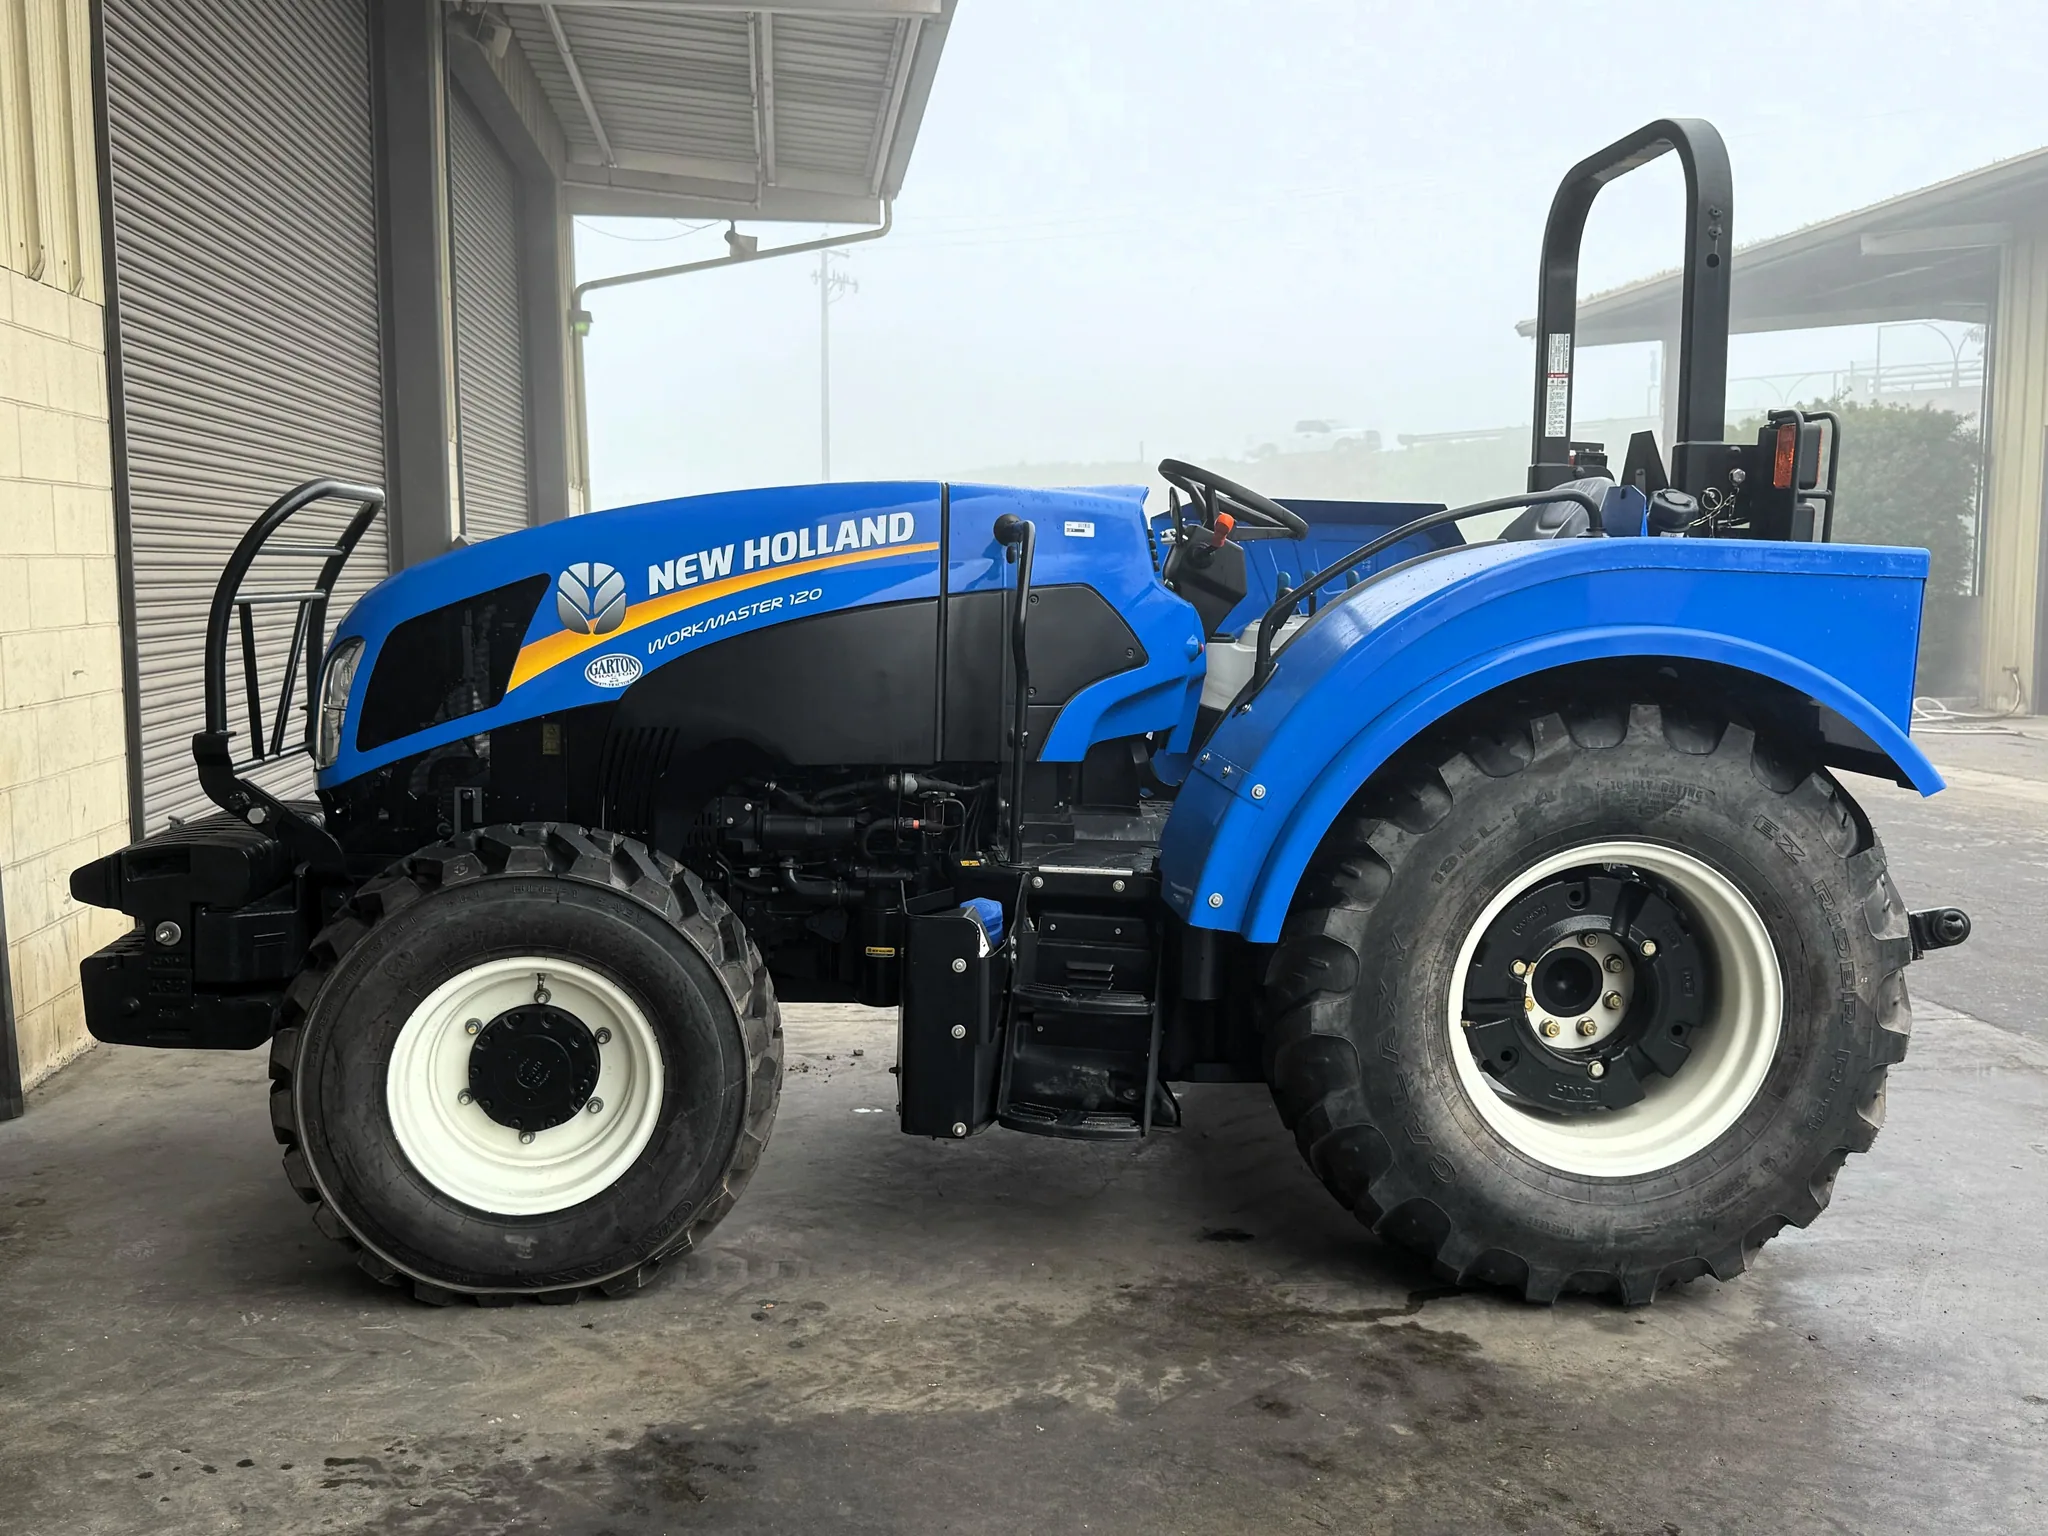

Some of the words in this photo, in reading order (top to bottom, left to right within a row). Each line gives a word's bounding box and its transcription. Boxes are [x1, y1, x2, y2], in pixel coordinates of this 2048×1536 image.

[648, 543, 735, 596] NEW
[743, 511, 915, 571] HOLLAND
[648, 596, 784, 655] WORKMASTER
[789, 587, 823, 606] 120
[589, 656, 638, 677] GARTON
[1753, 813, 1806, 865] EZ
[1810, 878, 1860, 1025] RIDER
